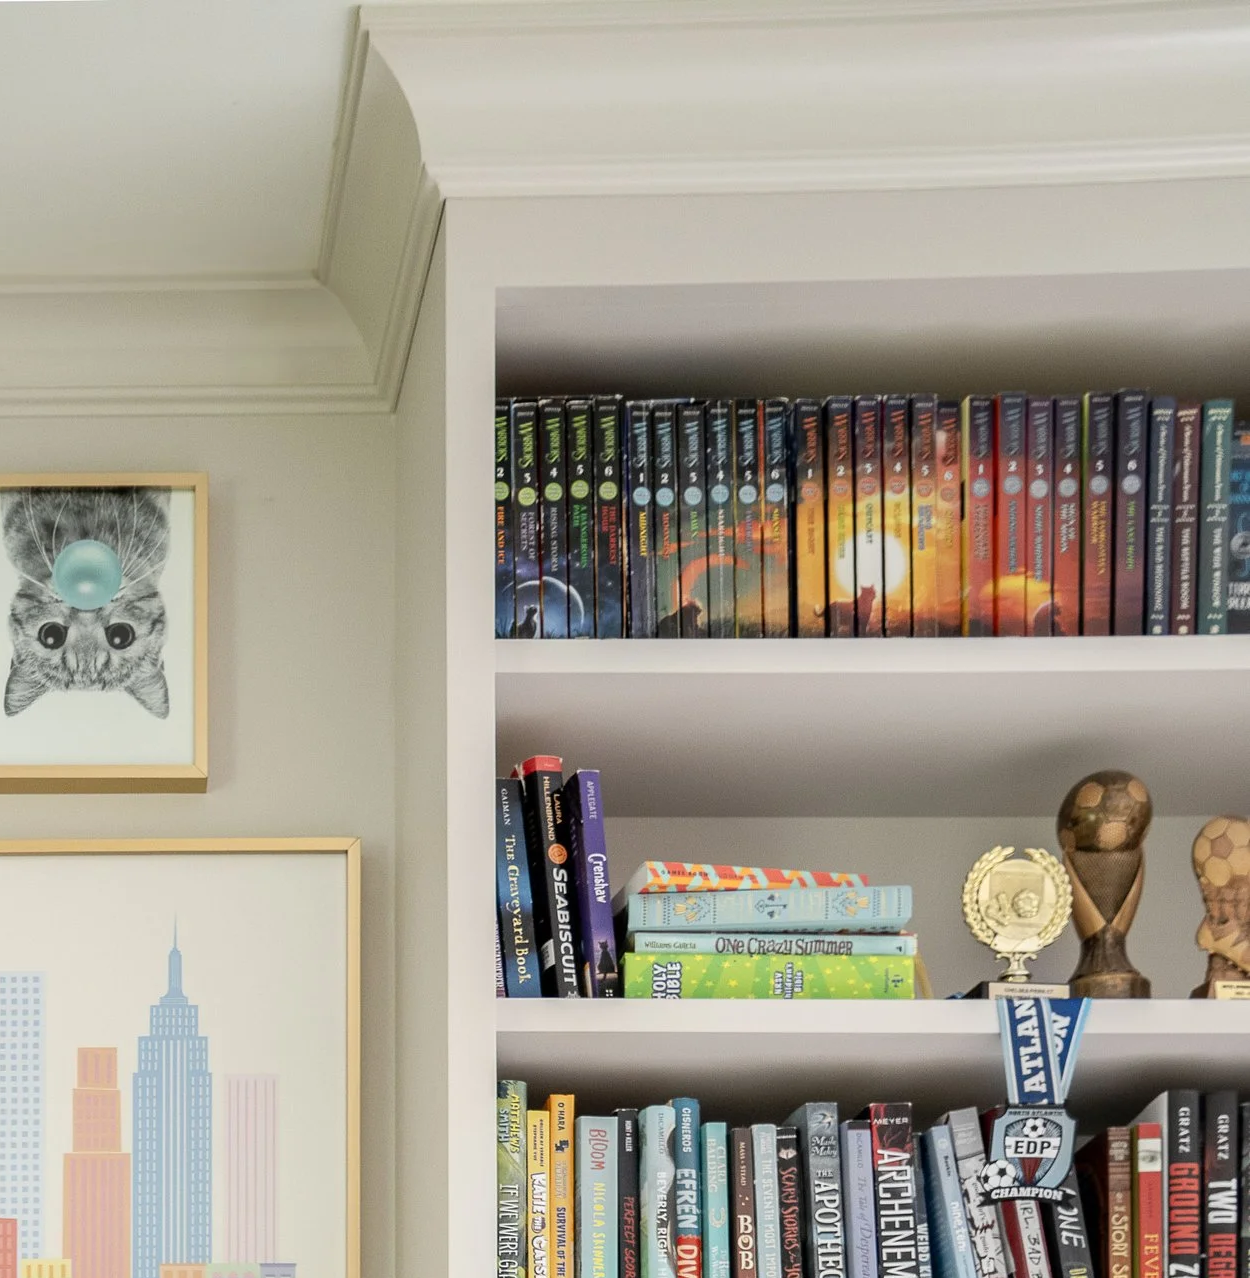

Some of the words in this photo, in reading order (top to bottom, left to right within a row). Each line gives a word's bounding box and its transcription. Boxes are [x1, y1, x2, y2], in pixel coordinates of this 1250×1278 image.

[496, 467, 505, 477] 2
[604, 466, 613, 476] 6
[497, 506, 505, 526] FIRE
[549, 506, 558, 538] RISING
[639, 511, 648, 557] MIDNIGHT
[497, 529, 505, 548] AND
[550, 540, 558, 573] STORM
[501, 788, 511, 826] GAIMAN
[543, 775, 556, 841] HILLENBRAND
[553, 793, 563, 825] LAURA
[586, 780, 598, 820] APPLEGATE
[587, 852, 610, 904] Crenshaw
[506, 864, 530, 944] Graveyard
[552, 867, 578, 987] SEABISCUIT
[515, 947, 532, 984] Book
[498, 1108, 510, 1144] SMITH
[510, 1093, 521, 1155] MATTHEWS
[557, 1102, 566, 1131] O'HARA
[681, 1107, 693, 1153] CISNEROS
[872, 1117, 909, 1125] MEYER
[1178, 1106, 1191, 1154] GRATZ
[589, 1128, 609, 1171] BLOOM
[1013, 1140, 1052, 1155] EDP
[1216, 1114, 1230, 1161] GRATZ
[499, 1183, 519, 1197] IF
[779, 1166, 799, 1205] SCARY
[815, 1169, 834, 1179] THE
[498, 1200, 519, 1220] WE
[530, 1172, 547, 1216] KATIE
[593, 1182, 607, 1227] NICOLA
[676, 1168, 701, 1229] EFRÉN
[761, 1178, 775, 1221] SEVENTH
[990, 1186, 1064, 1201] CHAMPION
[1169, 1162, 1200, 1255] GROUND
[1208, 1177, 1238, 1224] TWO
[498, 1222, 519, 1256] WERE
[531, 1216, 546, 1232] THE
[556, 1207, 567, 1248] SURVIVAL
[623, 1196, 635, 1247] PERFECT
[764, 1224, 776, 1249] MOST
[1111, 1213, 1129, 1258] STORY
[556, 1250, 567, 1260] OF
[592, 1232, 606, 1278] SKINNER
[656, 1226, 668, 1263] RIGHT
[737, 1214, 755, 1270] BOB
[1027, 1233, 1042, 1266] BAD
[556, 1261, 567, 1276] THE
